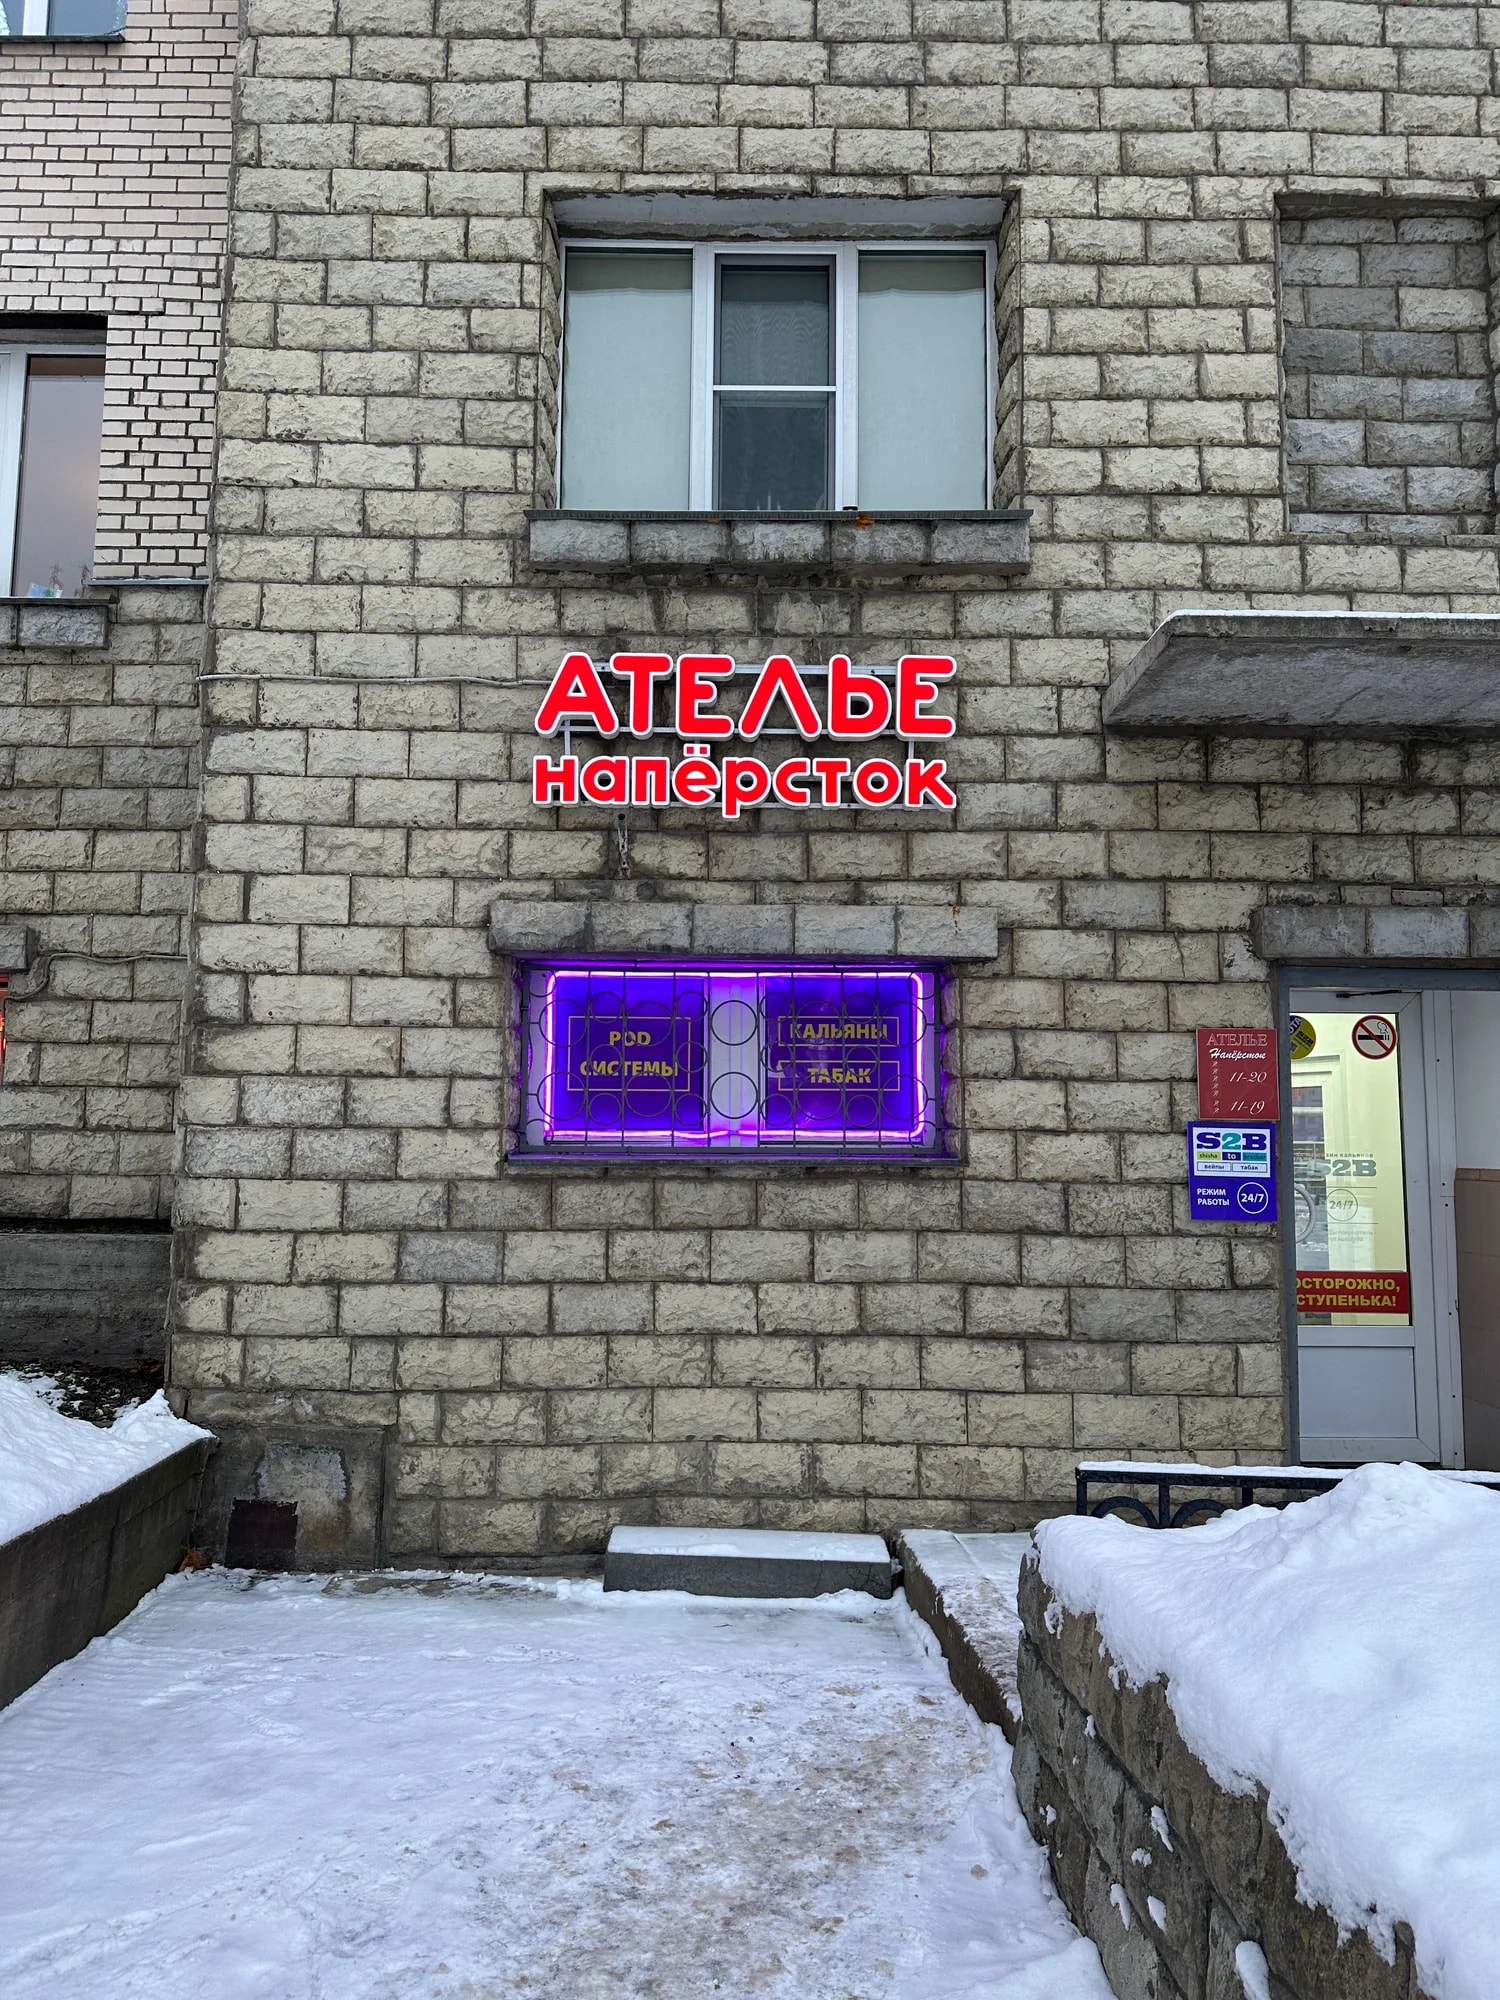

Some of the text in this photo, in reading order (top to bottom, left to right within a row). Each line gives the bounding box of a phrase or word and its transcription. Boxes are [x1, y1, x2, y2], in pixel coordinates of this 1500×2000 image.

[535, 652, 957, 741] АТЕЛЬЕ
[533, 744, 957, 819] напёрсток
[789, 1023, 888, 1040] КАЛЬЯНЫ
[608, 1031, 652, 1047] POD
[1206, 1033, 1269, 1047] АТЕЛЬЕ
[1208, 1047, 1267, 1061] Напёрсток
[579, 1060, 679, 1077] СИСТЕМЫ
[807, 1067, 872, 1084] ТАБАК
[1229, 1071, 1267, 1083] 11-20
[1230, 1100, 1266, 1115] 11-19
[1196, 1132, 1267, 1151] S2B
[1227, 1152, 1237, 1160] to
[1306, 1159, 1377, 1177] S2B
[1196, 1188, 1227, 1196] РЕЖИМ
[1241, 1193, 1265, 1203] 24/7
[1197, 1198, 1230, 1206] РАБОТЫ
[1329, 1200, 1354, 1210] 24/7
[1296, 1294, 1397, 1307] СТУПЕНЬКА!
